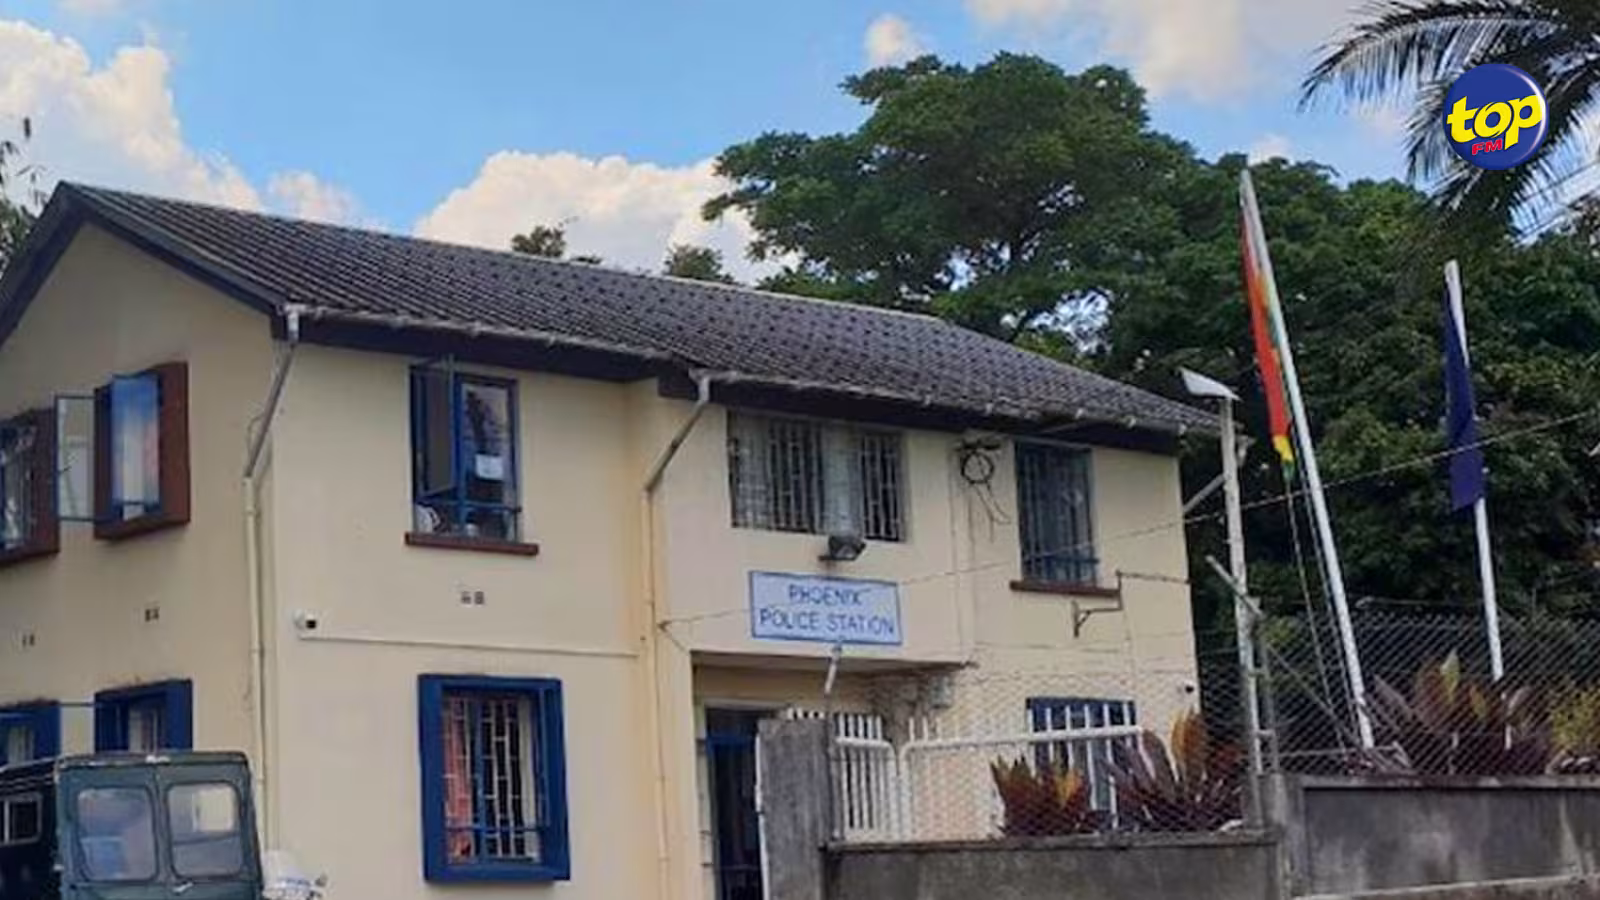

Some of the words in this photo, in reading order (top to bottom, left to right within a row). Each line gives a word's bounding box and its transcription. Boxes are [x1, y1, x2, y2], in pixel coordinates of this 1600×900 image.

[788, 584, 870, 606] PHOENIX
[759, 608, 820, 631] POLICE
[826, 613, 895, 635] STATION
